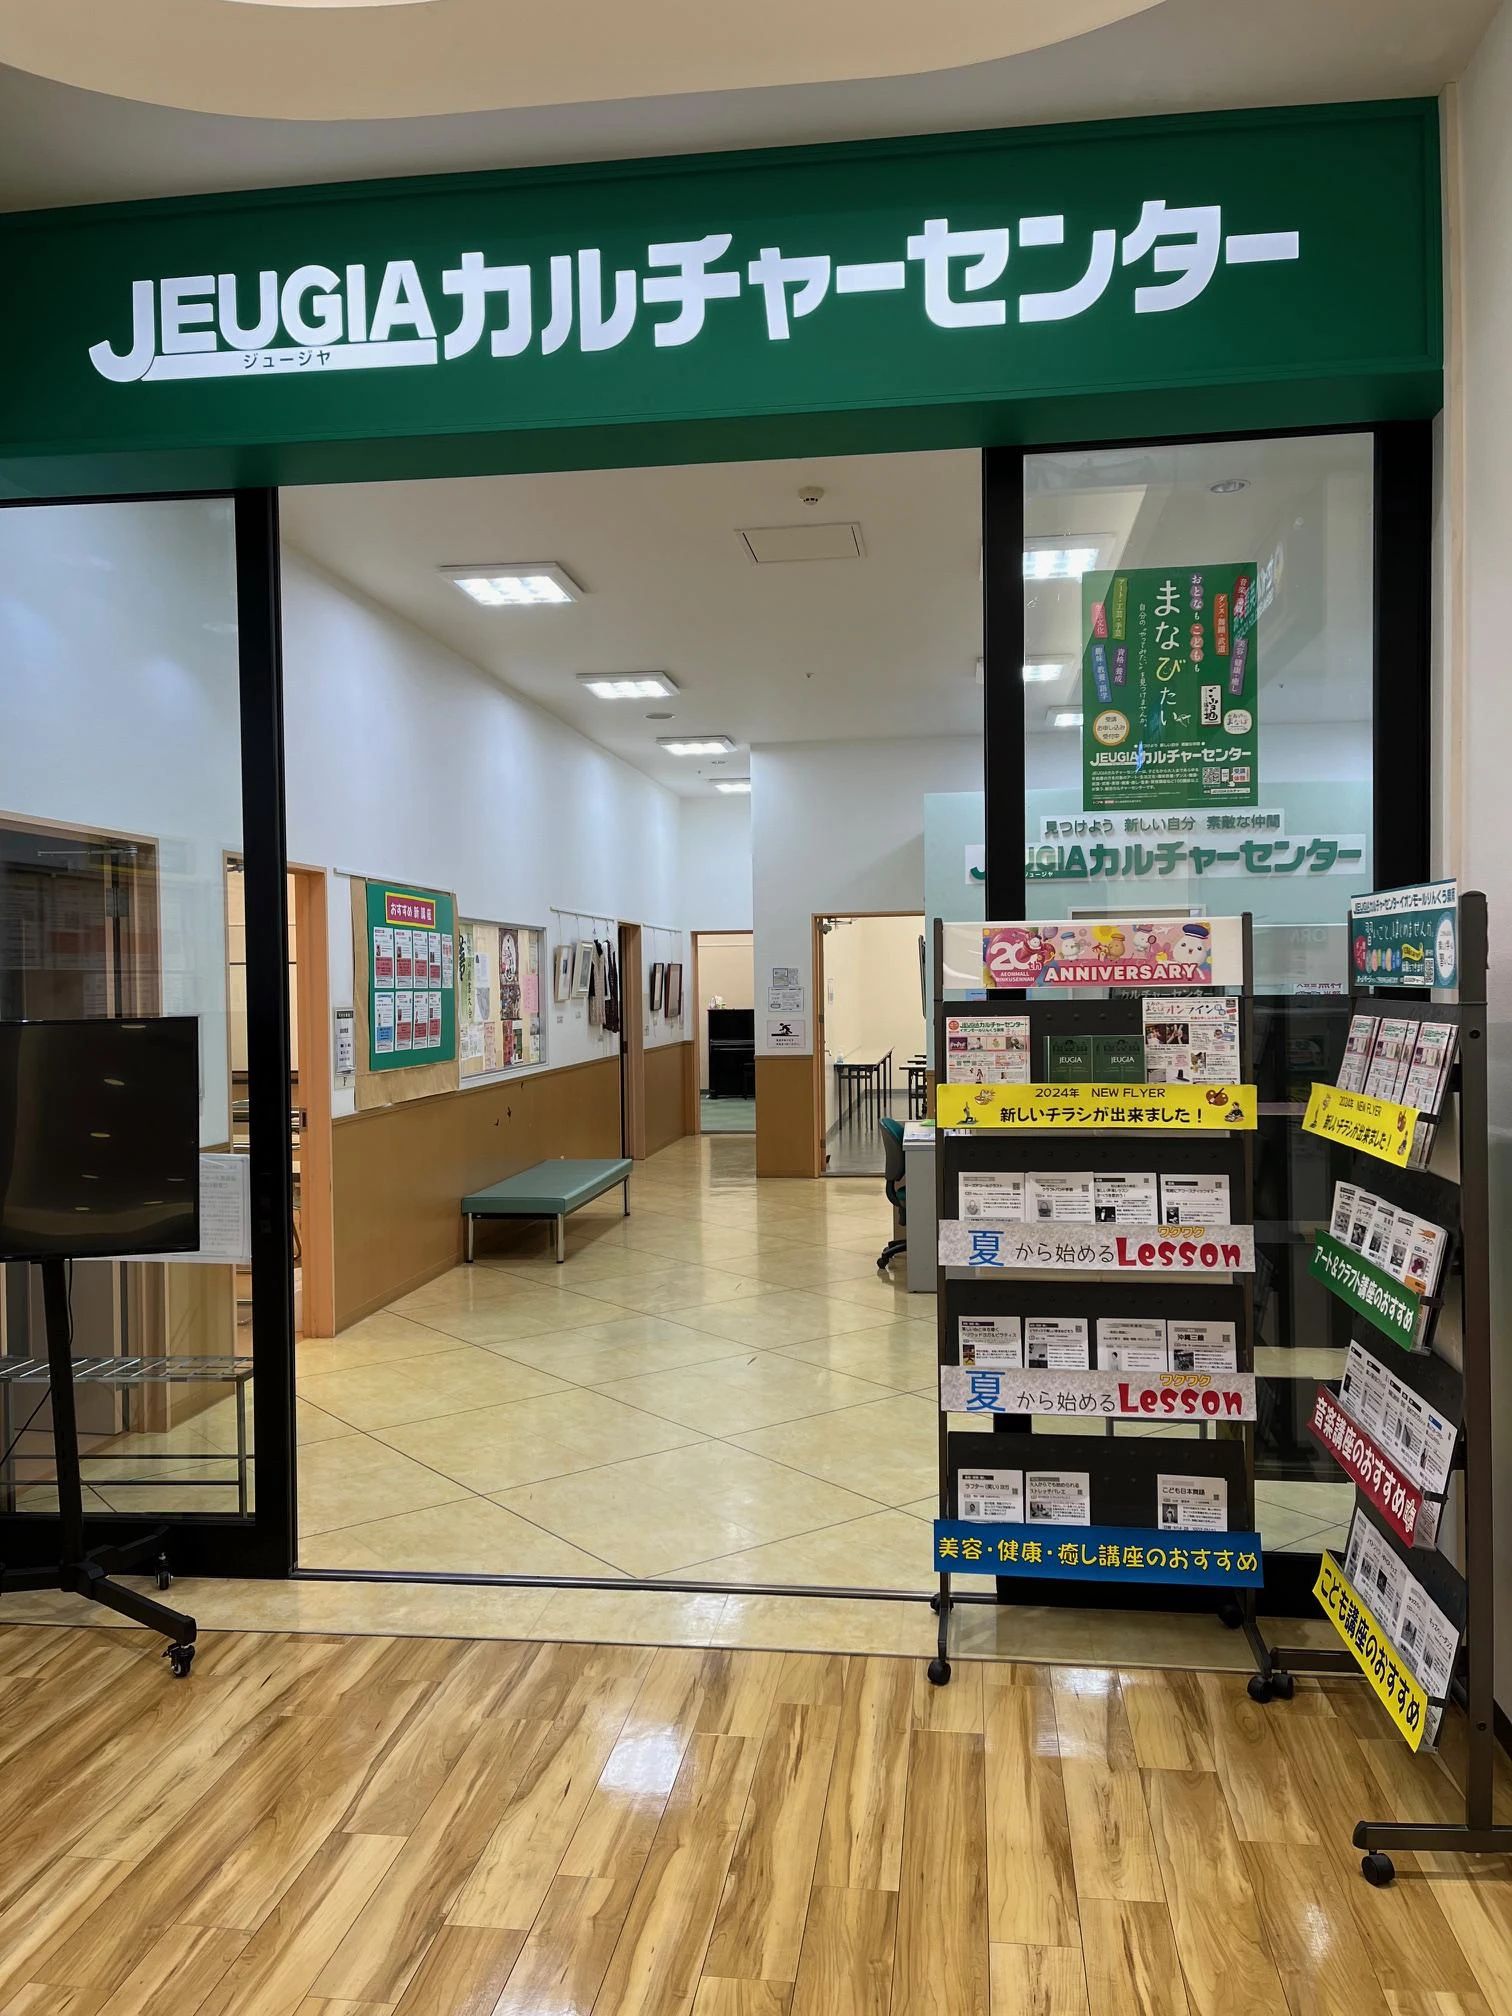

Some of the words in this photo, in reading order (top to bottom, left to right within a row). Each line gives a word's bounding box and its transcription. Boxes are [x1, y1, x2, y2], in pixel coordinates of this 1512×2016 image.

[88, 199, 1301, 383] JEUGIAカルチャーセンター
[1045, 818, 1113, 834] 見つけよう
[1124, 816, 1196, 832] 新しい自分
[1206, 814, 1281, 830] 素敵な仲間
[970, 838, 1362, 880] GIAカルチャーセンター
[1044, 963, 1197, 982] ANNIVERSARY
[1059, 1056, 1083, 1064] JEUGIA
[1111, 1056, 1135, 1064] JEUGIA
[1035, 1088, 1080, 1098] 2024年
[1091, 1088, 1120, 1098] NEW
[1123, 1088, 1166, 1098] FLYER
[1000, 1107, 1202, 1123] 新しいチラシが出来ました！
[1157, 1226, 1206, 1238] ワクワク
[968, 1230, 1005, 1266] 夏
[1015, 1243, 1115, 1263] から始める
[1115, 1237, 1241, 1268] Lesson
[1159, 1373, 1212, 1387] ワクワク
[965, 1370, 1006, 1413] 夏
[1017, 1390, 1116, 1413] から始める
[1118, 1383, 1243, 1416] Lesson
[938, 1537, 1258, 1572] 美容・健康・癒し講座のおすすめ
[1320, 1567, 1421, 1731] こども講座のおすすめ
